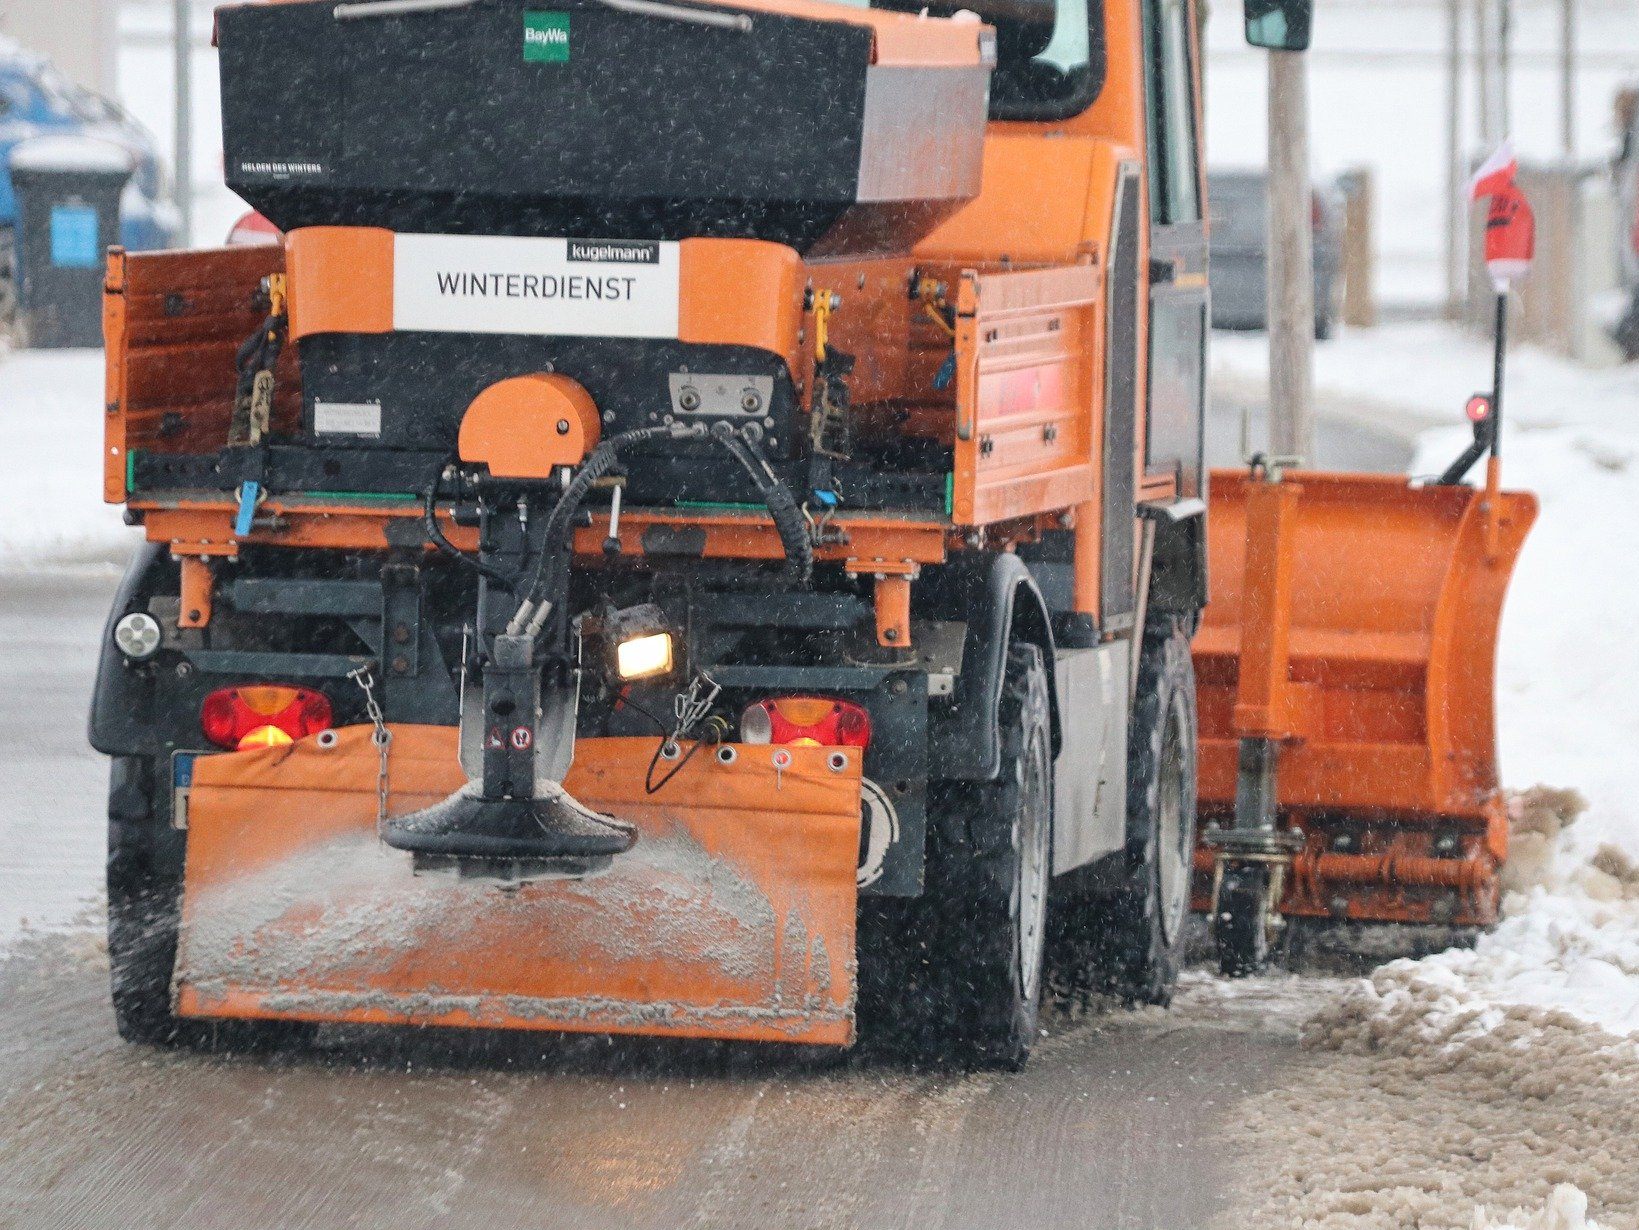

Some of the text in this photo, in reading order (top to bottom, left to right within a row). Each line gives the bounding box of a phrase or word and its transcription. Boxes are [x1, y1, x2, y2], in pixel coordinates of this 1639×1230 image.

[525, 27, 567, 46] BayWa
[241, 162, 322, 174] HELDEN DES WINTERS
[436, 270, 637, 300] WINTERDIENST
